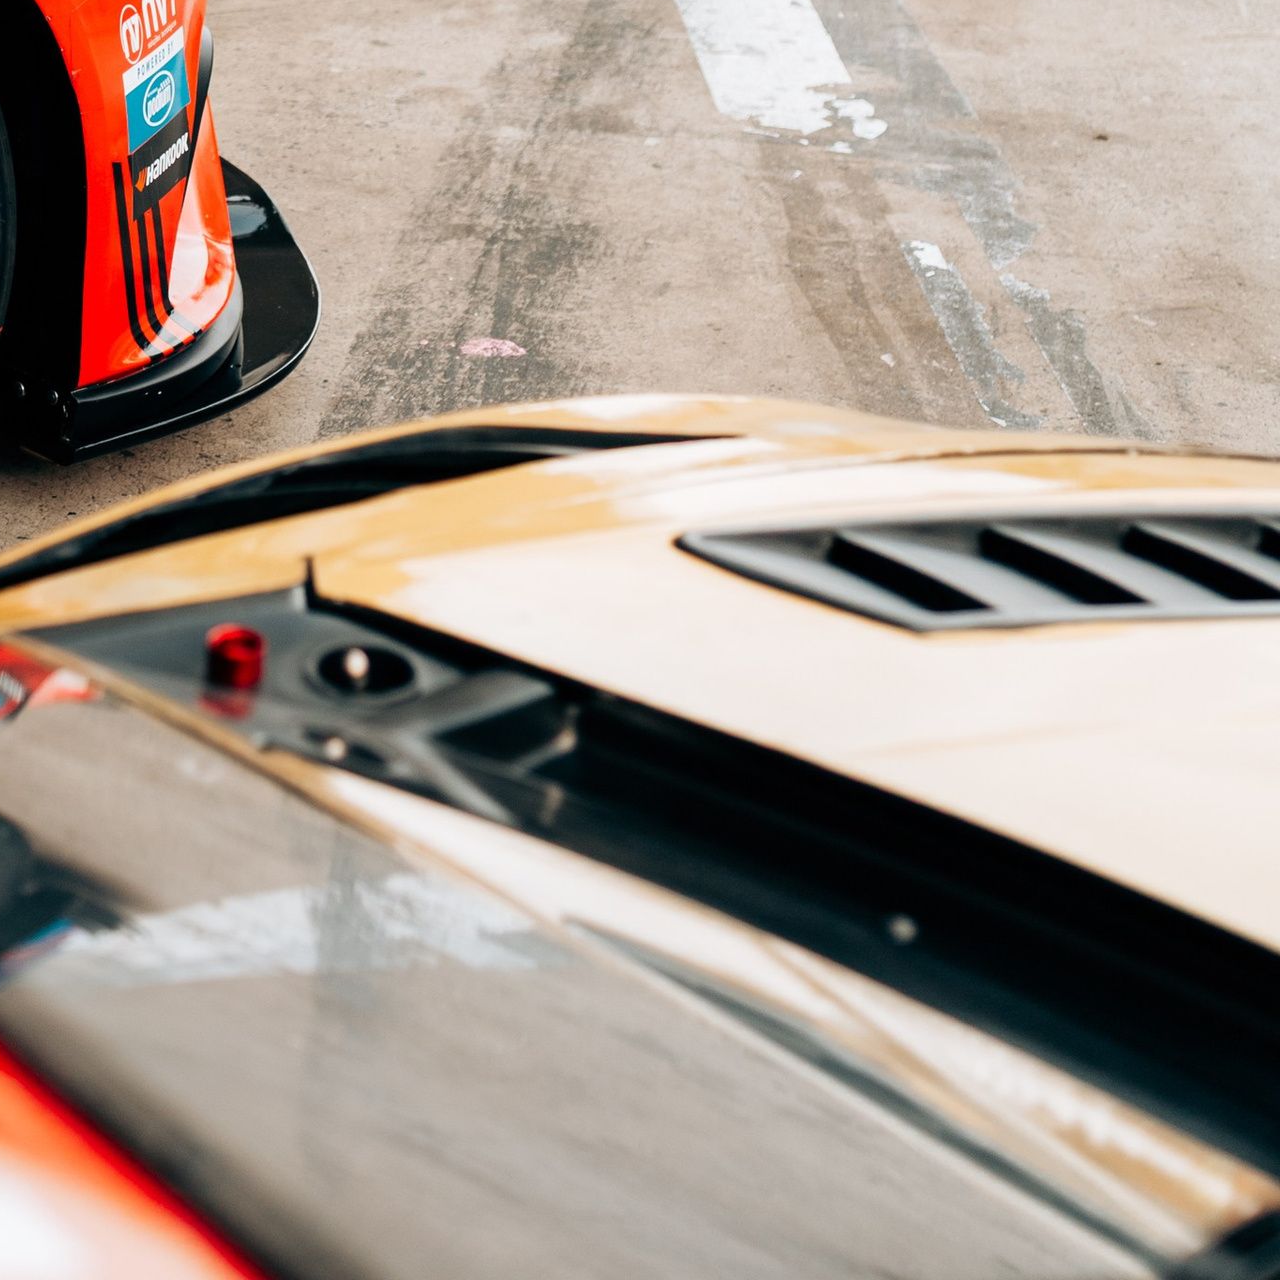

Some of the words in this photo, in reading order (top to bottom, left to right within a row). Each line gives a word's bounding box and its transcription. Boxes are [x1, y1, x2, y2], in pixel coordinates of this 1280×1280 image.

[136, 49, 166, 79] POWERED
[167, 41, 175, 55] BY
[146, 132, 189, 187] Hankook
